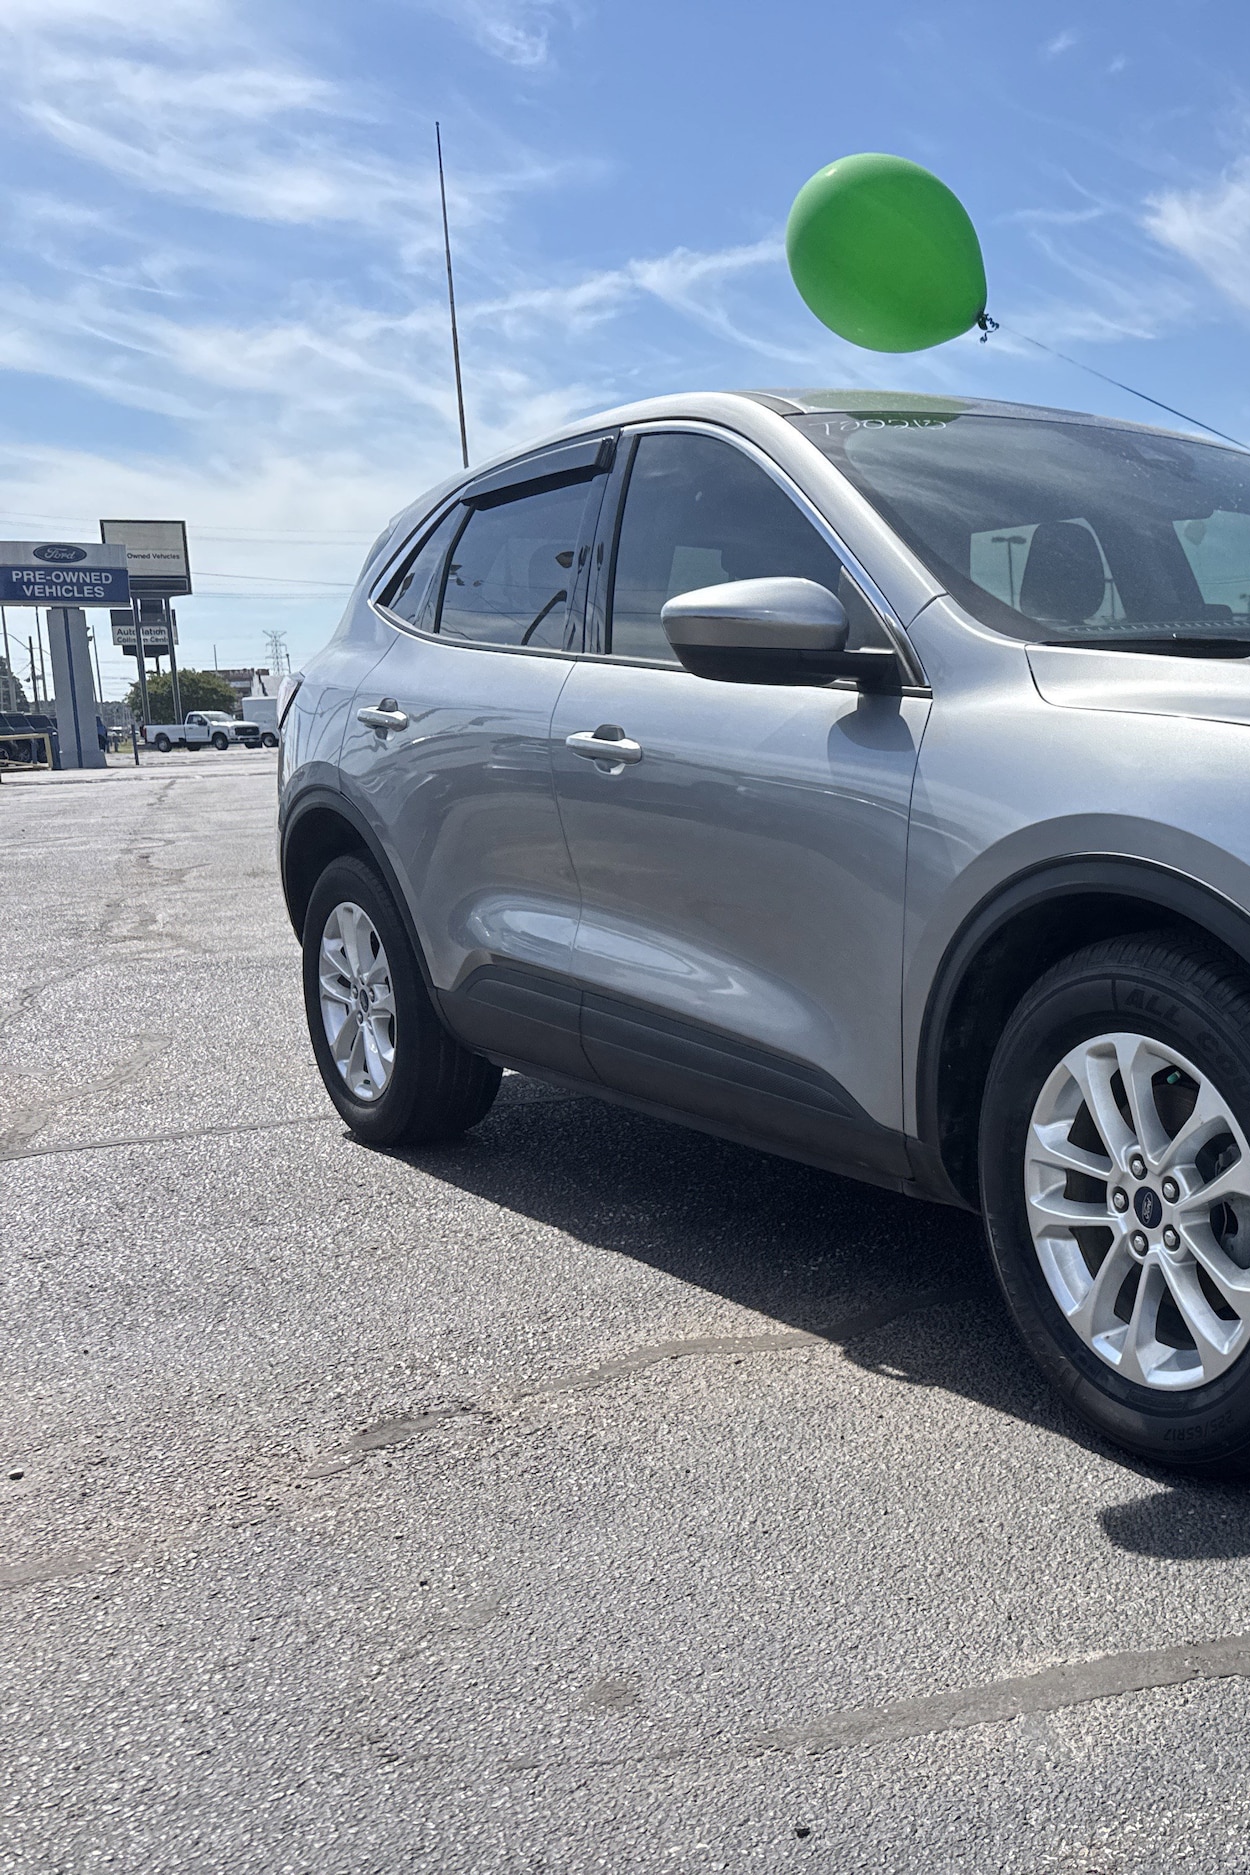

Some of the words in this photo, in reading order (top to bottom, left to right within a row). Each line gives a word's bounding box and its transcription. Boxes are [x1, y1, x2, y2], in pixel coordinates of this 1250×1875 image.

[44, 547, 77, 559] Ford
[12, 570, 113, 584] PRE-OWNED
[23, 585, 105, 598] VEHICLES
[1123, 988, 1182, 1027] ALL
[1162, 1409, 1235, 1441] 225/65R17
